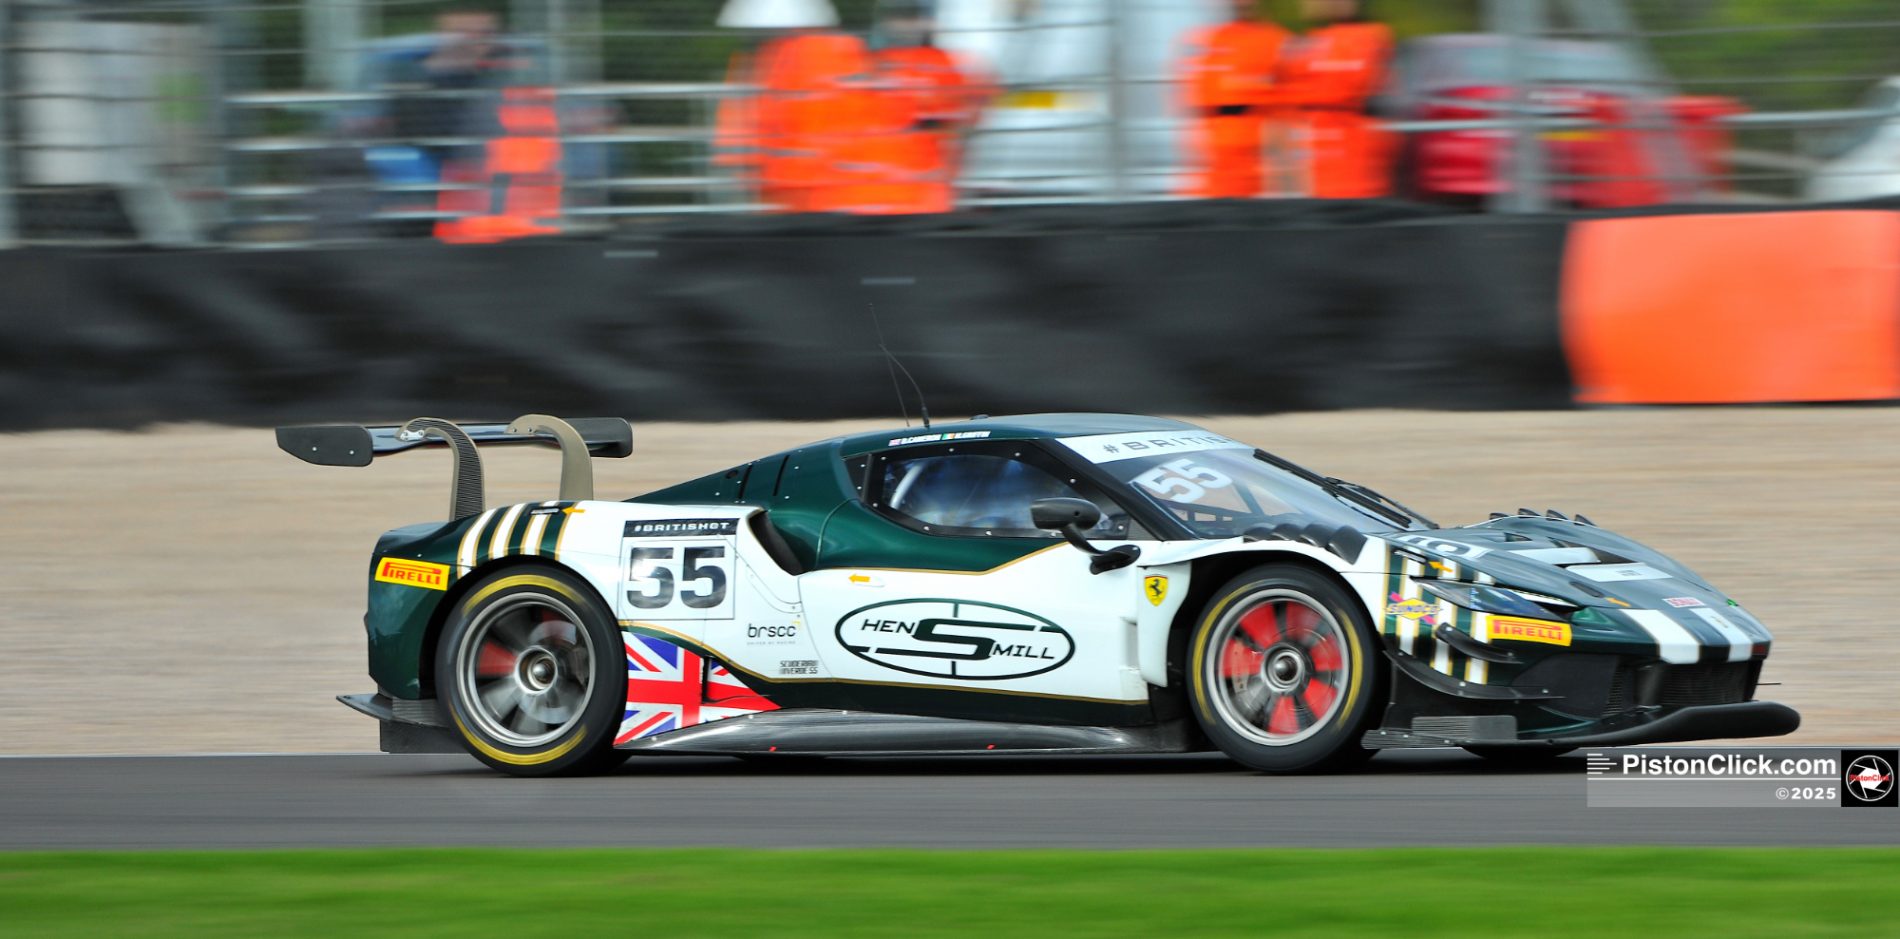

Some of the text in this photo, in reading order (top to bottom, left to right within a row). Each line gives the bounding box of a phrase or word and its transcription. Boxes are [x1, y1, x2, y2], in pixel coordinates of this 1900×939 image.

[1133, 458, 1233, 503] 55
[381, 562, 442, 585] PIRELLI
[626, 546, 727, 609] 55
[747, 623, 796, 638] brscc
[1492, 619, 1563, 641] PIRELLI
